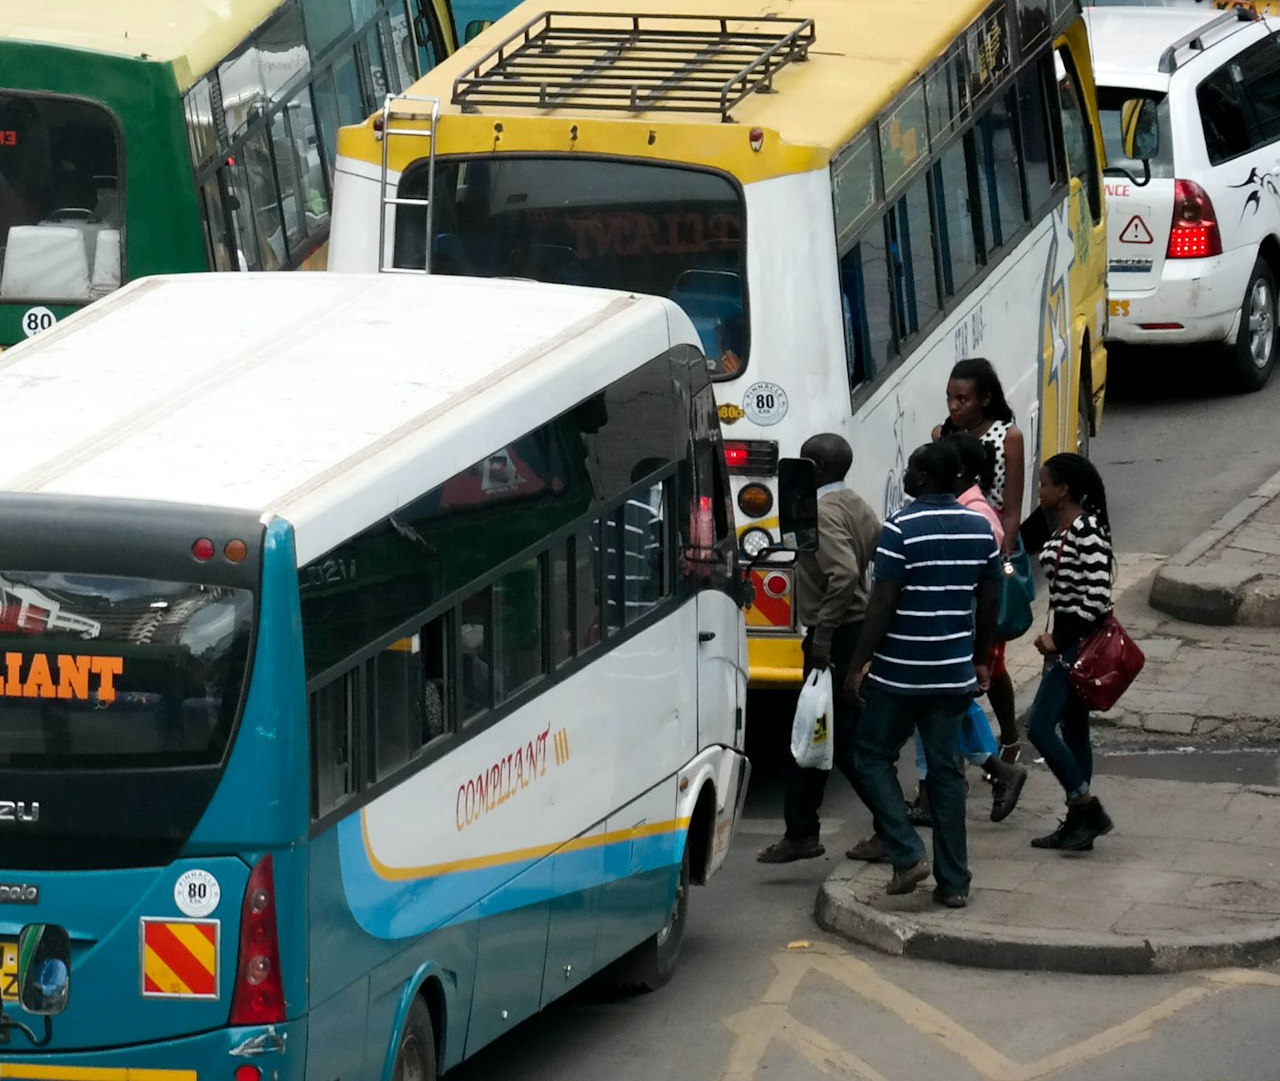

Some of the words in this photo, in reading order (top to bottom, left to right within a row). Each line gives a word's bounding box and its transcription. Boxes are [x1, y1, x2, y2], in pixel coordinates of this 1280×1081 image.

[1104, 184, 1130, 197] NCE
[1110, 300, 1130, 318] ES
[26, 313, 53, 331] 80
[756, 394, 775, 409] 80
[456, 721, 550, 832] COMPLIANT
[188, 883, 206, 899] 80
